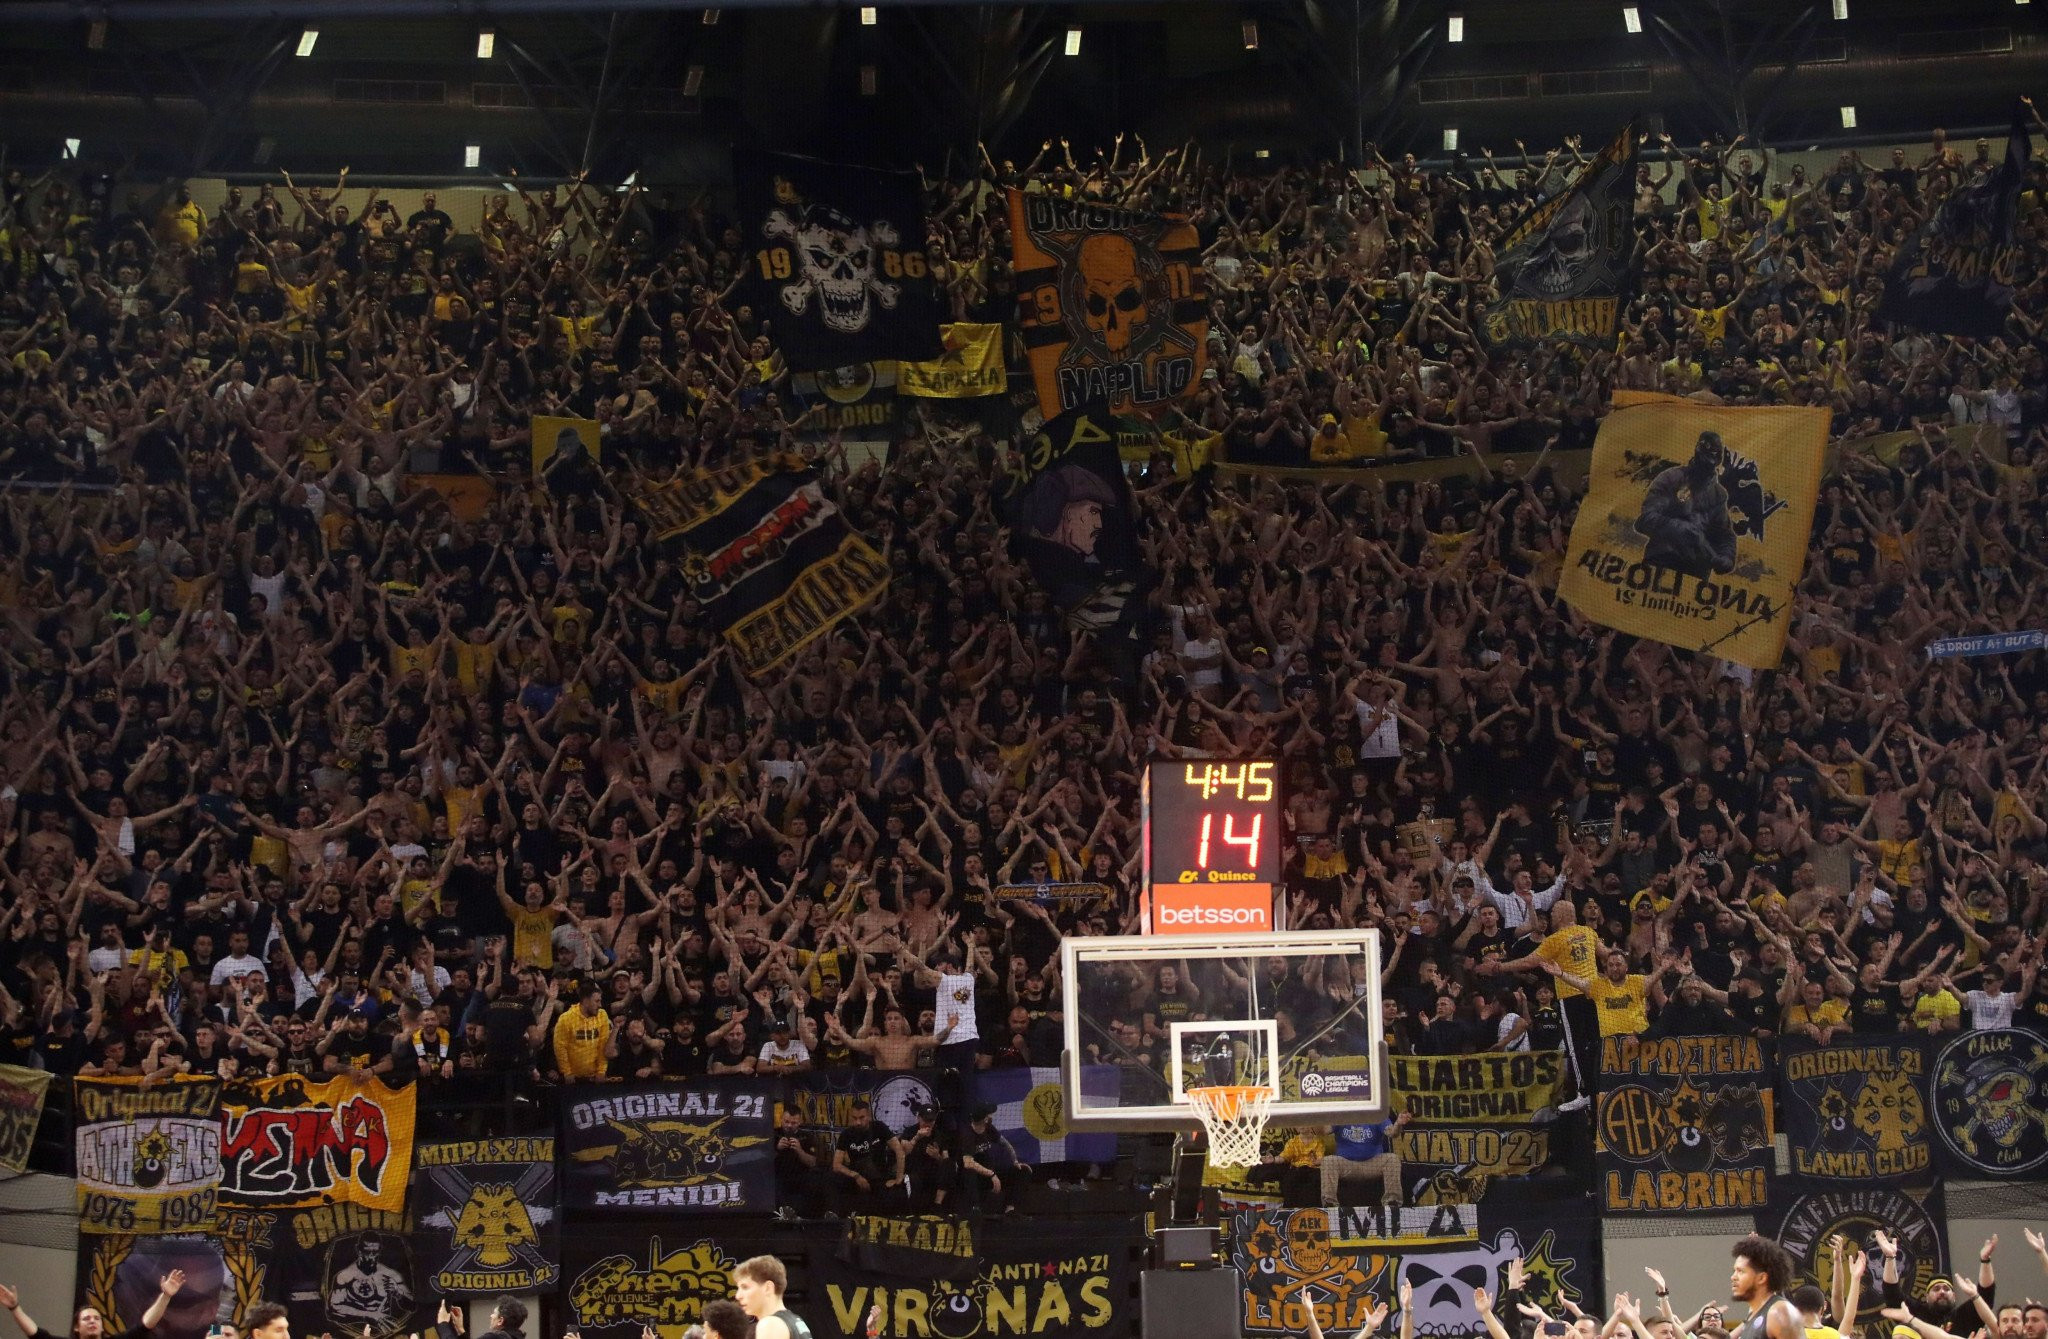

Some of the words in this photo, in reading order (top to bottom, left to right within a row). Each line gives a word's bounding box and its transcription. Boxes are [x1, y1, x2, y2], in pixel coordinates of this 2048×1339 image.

[757, 247, 791, 280] 19
[884, 249, 927, 279] 86
[1947, 640, 1982, 652] DROIT
[2005, 634, 2030, 647] BUT
[1185, 762, 1274, 801] 4:45
[1199, 813, 1261, 868] 14
[1208, 870, 1256, 882] Quince
[1161, 904, 1264, 924] betsson
[1787, 1048, 1895, 1081] ORIGINAL
[1900, 1049, 1923, 1075] 21
[80, 1084, 190, 1123] Original
[572, 1092, 725, 1130] ORIGINAL
[733, 1094, 766, 1118] 21
[1407, 1091, 1533, 1118] ORIGINAL
[1606, 1089, 1665, 1155] AEK
[1796, 1147, 1873, 1178] LAMIA
[1874, 1142, 1930, 1176] CLUB
[1997, 1148, 2021, 1163] Club
[595, 1182, 741, 1205] MENIDI
[1607, 1167, 1767, 1211] LABRINI
[82, 1192, 136, 1230] 1975
[160, 1188, 219, 1230] 1982
[1300, 1217, 1322, 1229] AEK
[439, 1271, 531, 1289] ORIGINAL
[535, 1266, 552, 1283] 21
[989, 1263, 1040, 1282] ANTI
[1058, 1254, 1109, 1275] NAZI
[603, 1293, 655, 1304] VIOLENCE
[1247, 1289, 1378, 1329] LIOSIA
